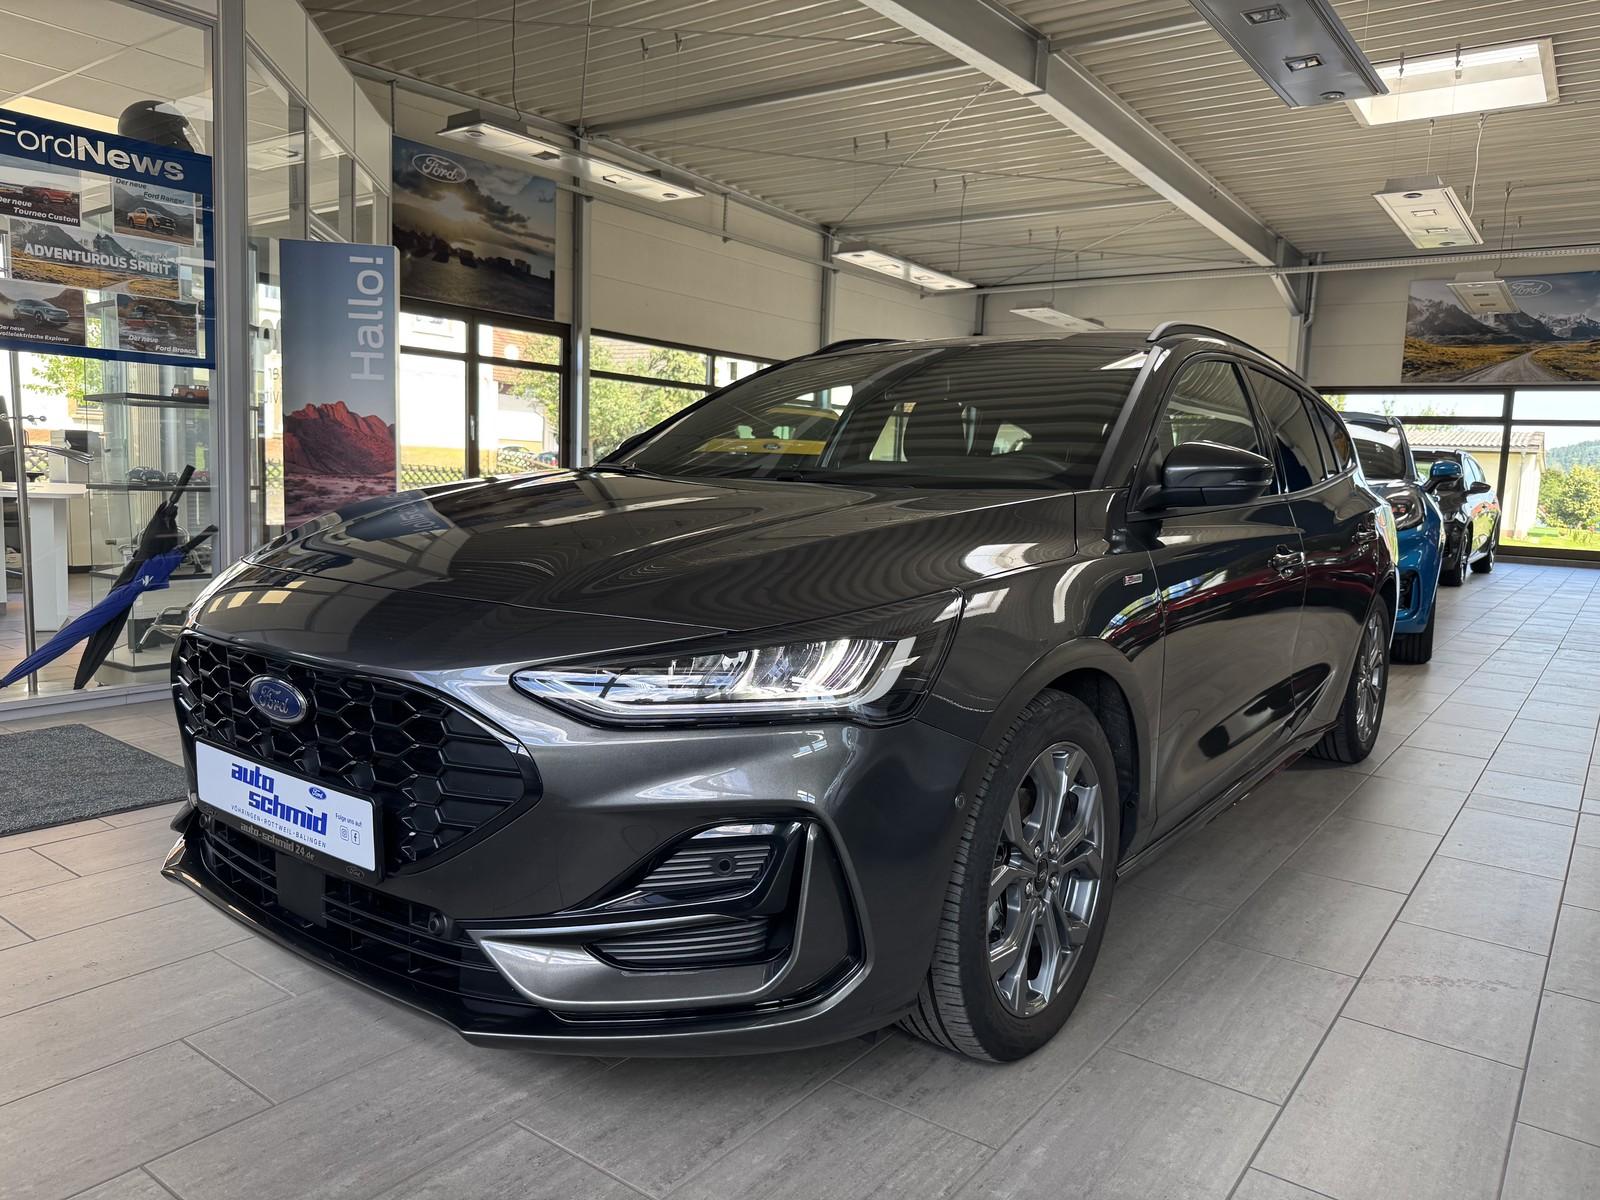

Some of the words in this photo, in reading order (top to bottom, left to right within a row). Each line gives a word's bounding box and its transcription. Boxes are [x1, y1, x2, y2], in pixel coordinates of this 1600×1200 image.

[0, 119, 185, 181] FordNews
[422, 156, 457, 180] Ford
[115, 178, 129, 186] Der
[129, 181, 147, 190] neue
[144, 191, 160, 199] Ford
[12, 199, 32, 208] neue
[13, 206, 47, 218] Tourneo
[48, 212, 79, 224] Custom
[23, 242, 128, 270] ADVENTUROUS
[129, 259, 171, 276] SPIRIT
[1511, 282, 1544, 296] Ford
[347, 255, 385, 381] Hallo!
[155, 344, 172, 353] Ford
[172, 346, 197, 354] Bronco
[259, 685, 289, 714] Ford
[232, 763, 274, 793] auto
[249, 791, 327, 835] schmid
